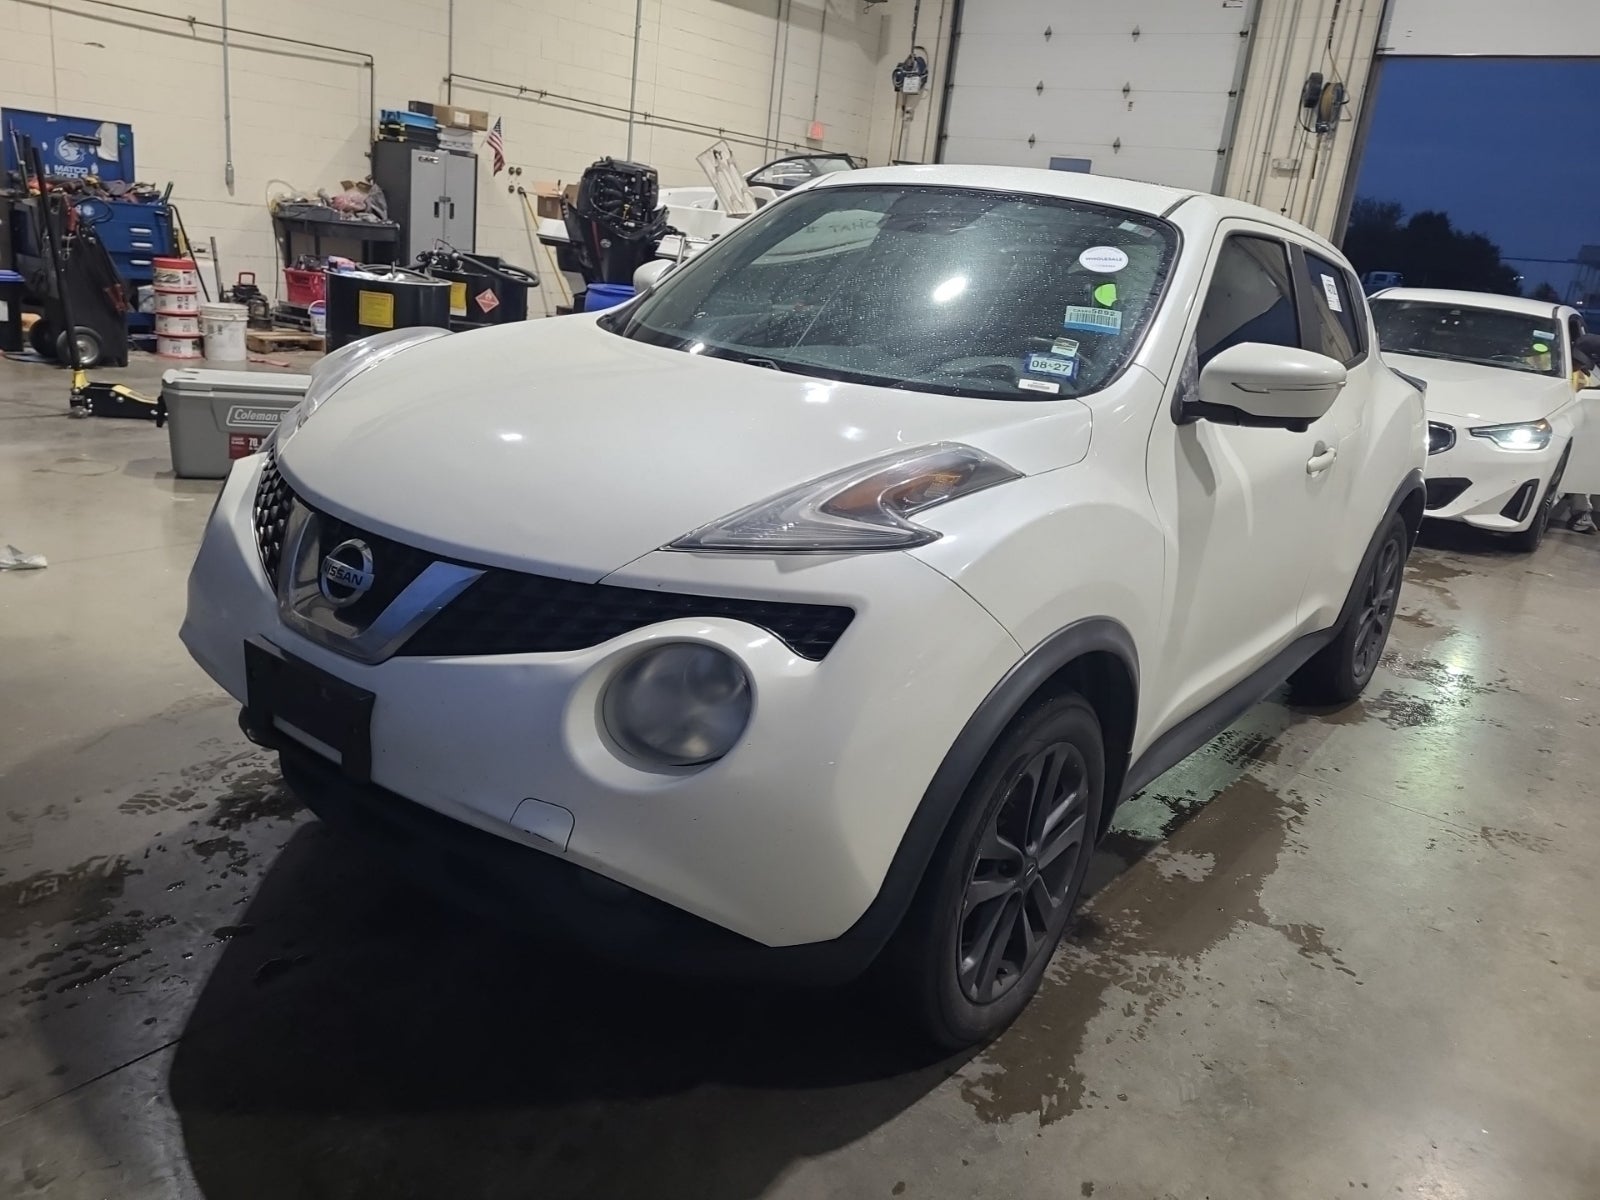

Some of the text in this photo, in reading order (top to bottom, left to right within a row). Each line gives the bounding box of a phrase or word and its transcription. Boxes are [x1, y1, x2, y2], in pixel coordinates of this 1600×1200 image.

[54, 165, 88, 173] MATCO
[1053, 363, 1070, 372] 27
[234, 409, 278, 421] Coleman
[325, 561, 363, 586] NISSAN
